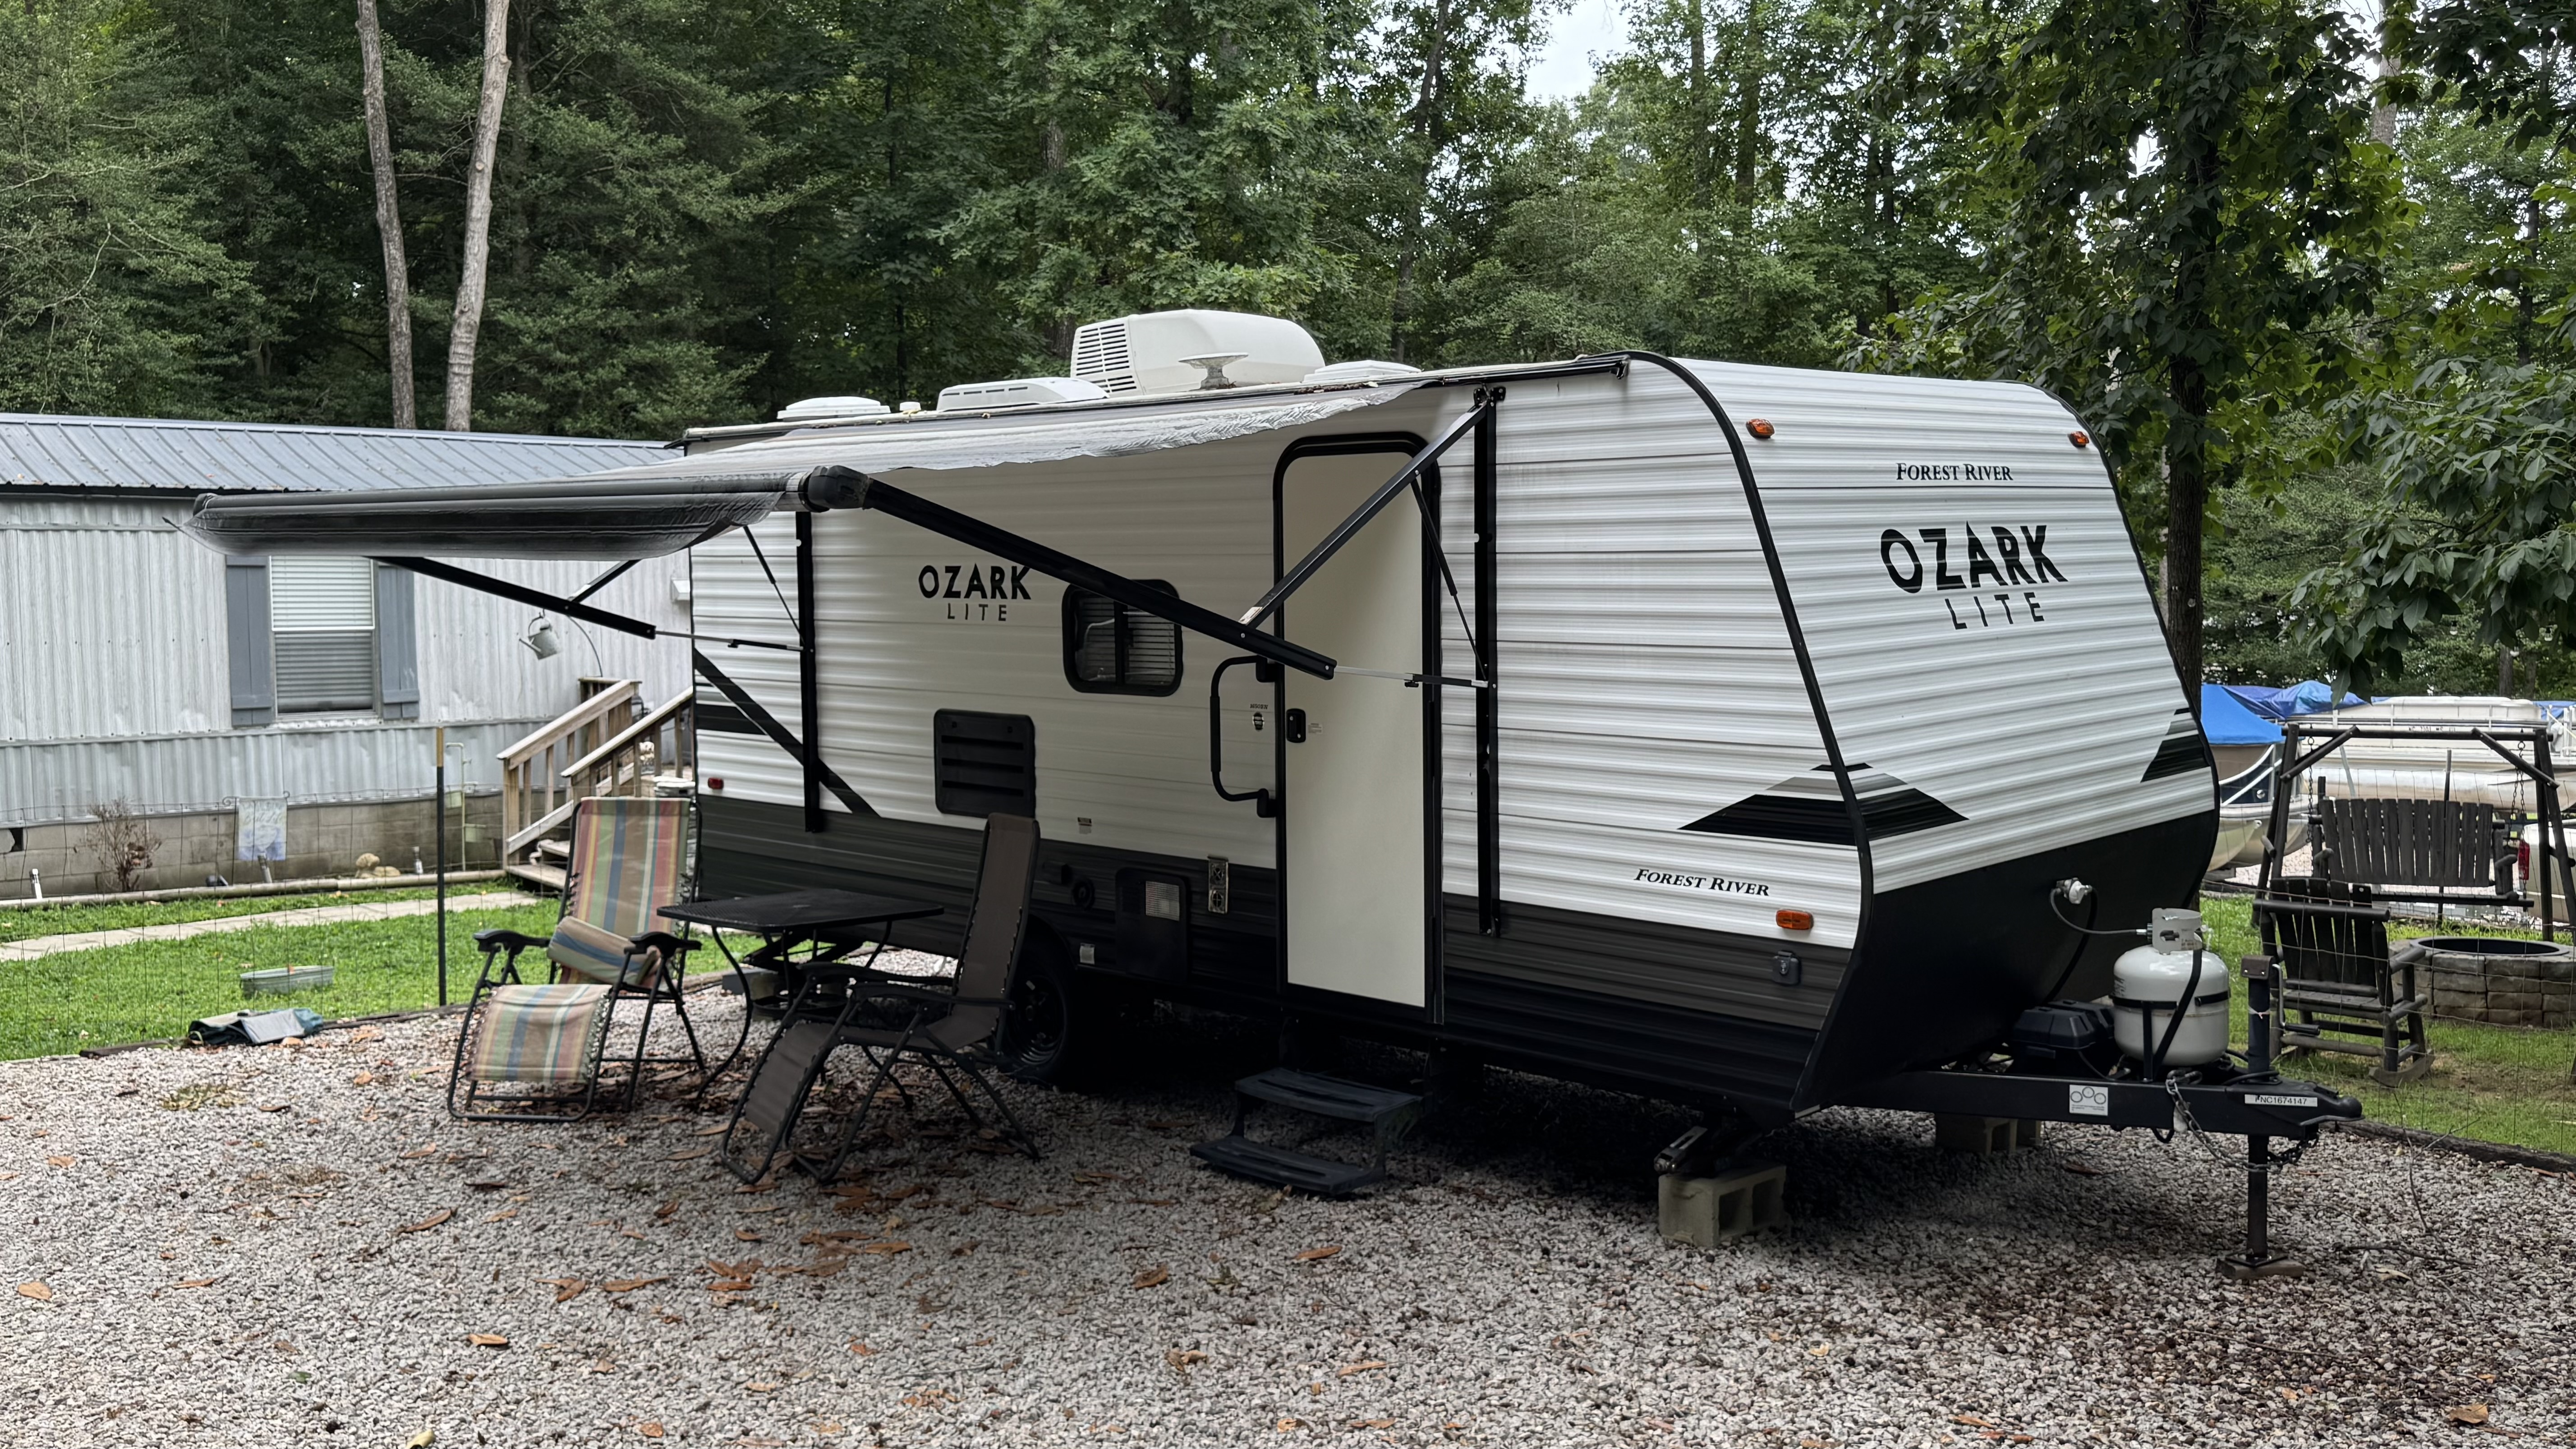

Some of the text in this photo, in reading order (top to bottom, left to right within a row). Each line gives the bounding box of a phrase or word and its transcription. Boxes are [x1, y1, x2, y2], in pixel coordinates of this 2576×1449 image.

[1895, 463, 2014, 481] FOREST RIVER
[1880, 520, 2069, 594] OZARK
[918, 563, 1031, 600] OZARK
[947, 603, 1007, 621] LITE
[1944, 591, 2045, 630] LITE
[1633, 868, 1770, 897] FOREST RIVER
